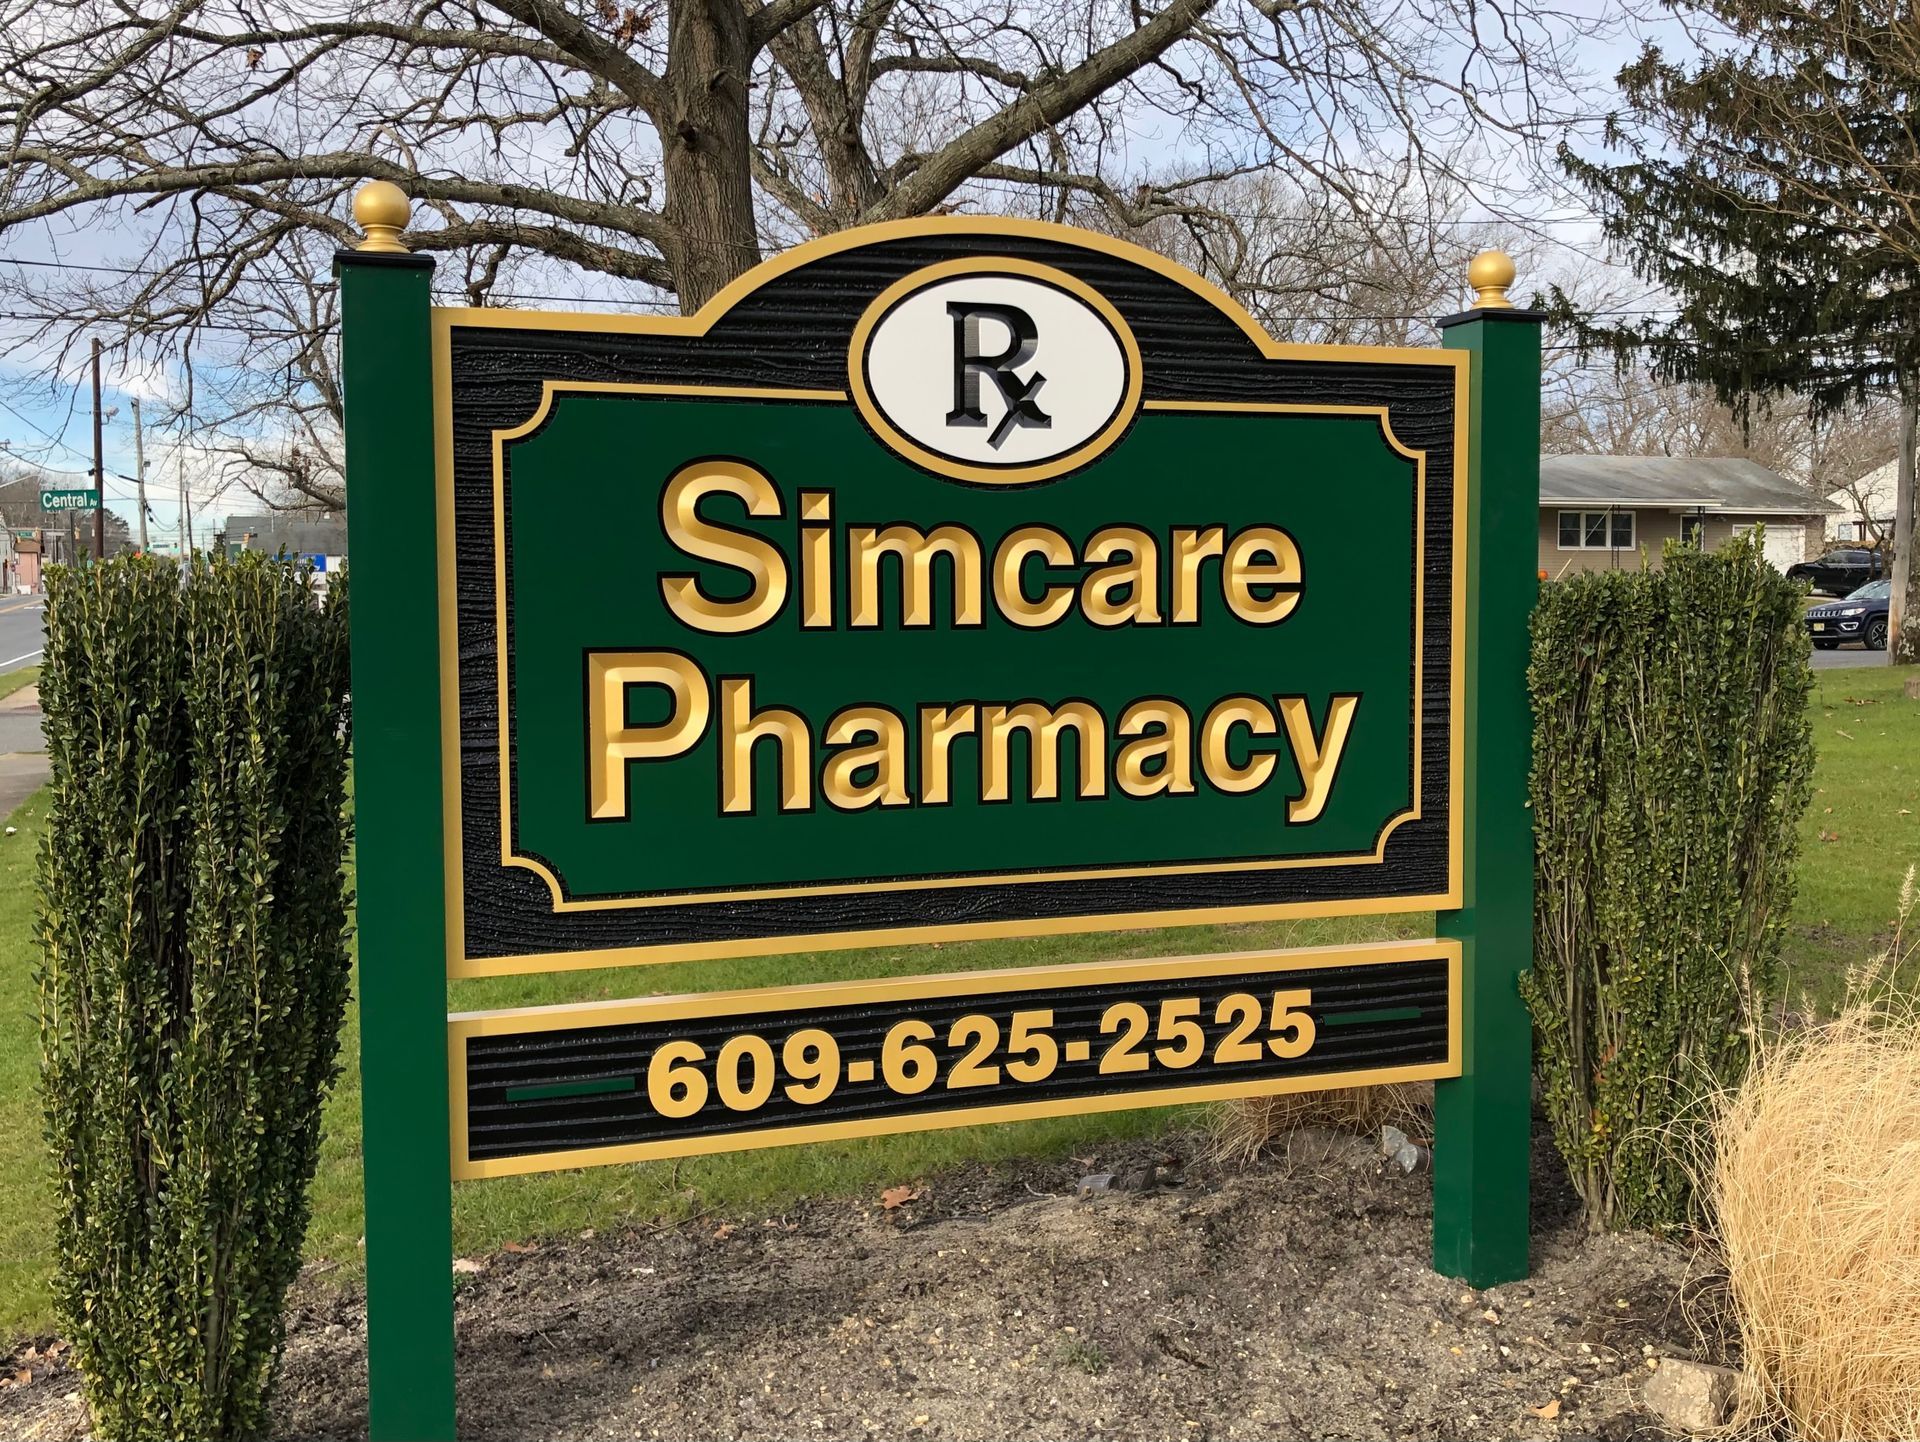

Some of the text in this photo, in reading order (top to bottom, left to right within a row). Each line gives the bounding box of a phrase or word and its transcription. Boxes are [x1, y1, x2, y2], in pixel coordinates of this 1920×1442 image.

[42, 492, 88, 508] Central
[659, 457, 1305, 635] Simcare
[585, 650, 1361, 823] Pharmacy
[646, 988, 1317, 1118] 609-625-2525
